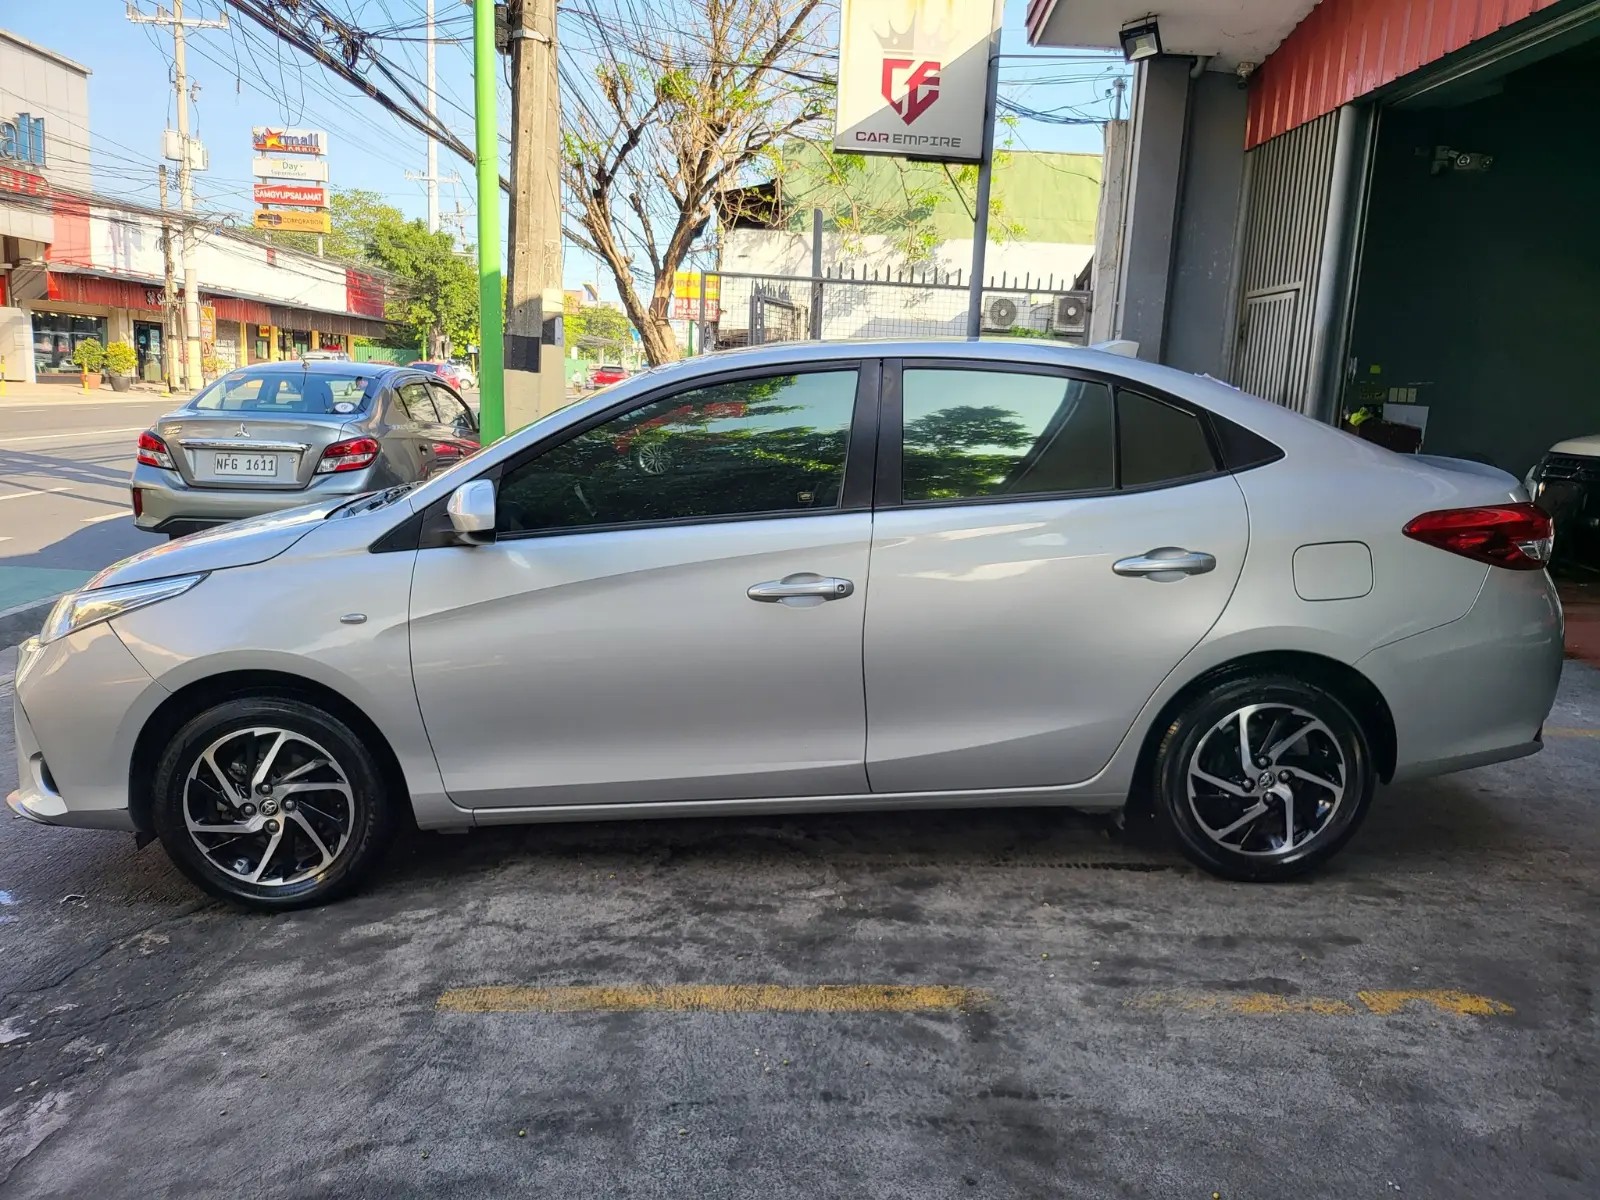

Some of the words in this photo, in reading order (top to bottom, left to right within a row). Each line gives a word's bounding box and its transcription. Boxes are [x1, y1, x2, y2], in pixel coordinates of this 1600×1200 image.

[253, 129, 318, 148] strmall
[855, 131, 889, 143] CAR
[892, 133, 962, 148] EMPIRE
[282, 161, 298, 171] Day
[254, 189, 322, 201] SAMGYUPSALAMAT
[216, 458, 238, 470] NFG
[246, 459, 274, 471] 1611
